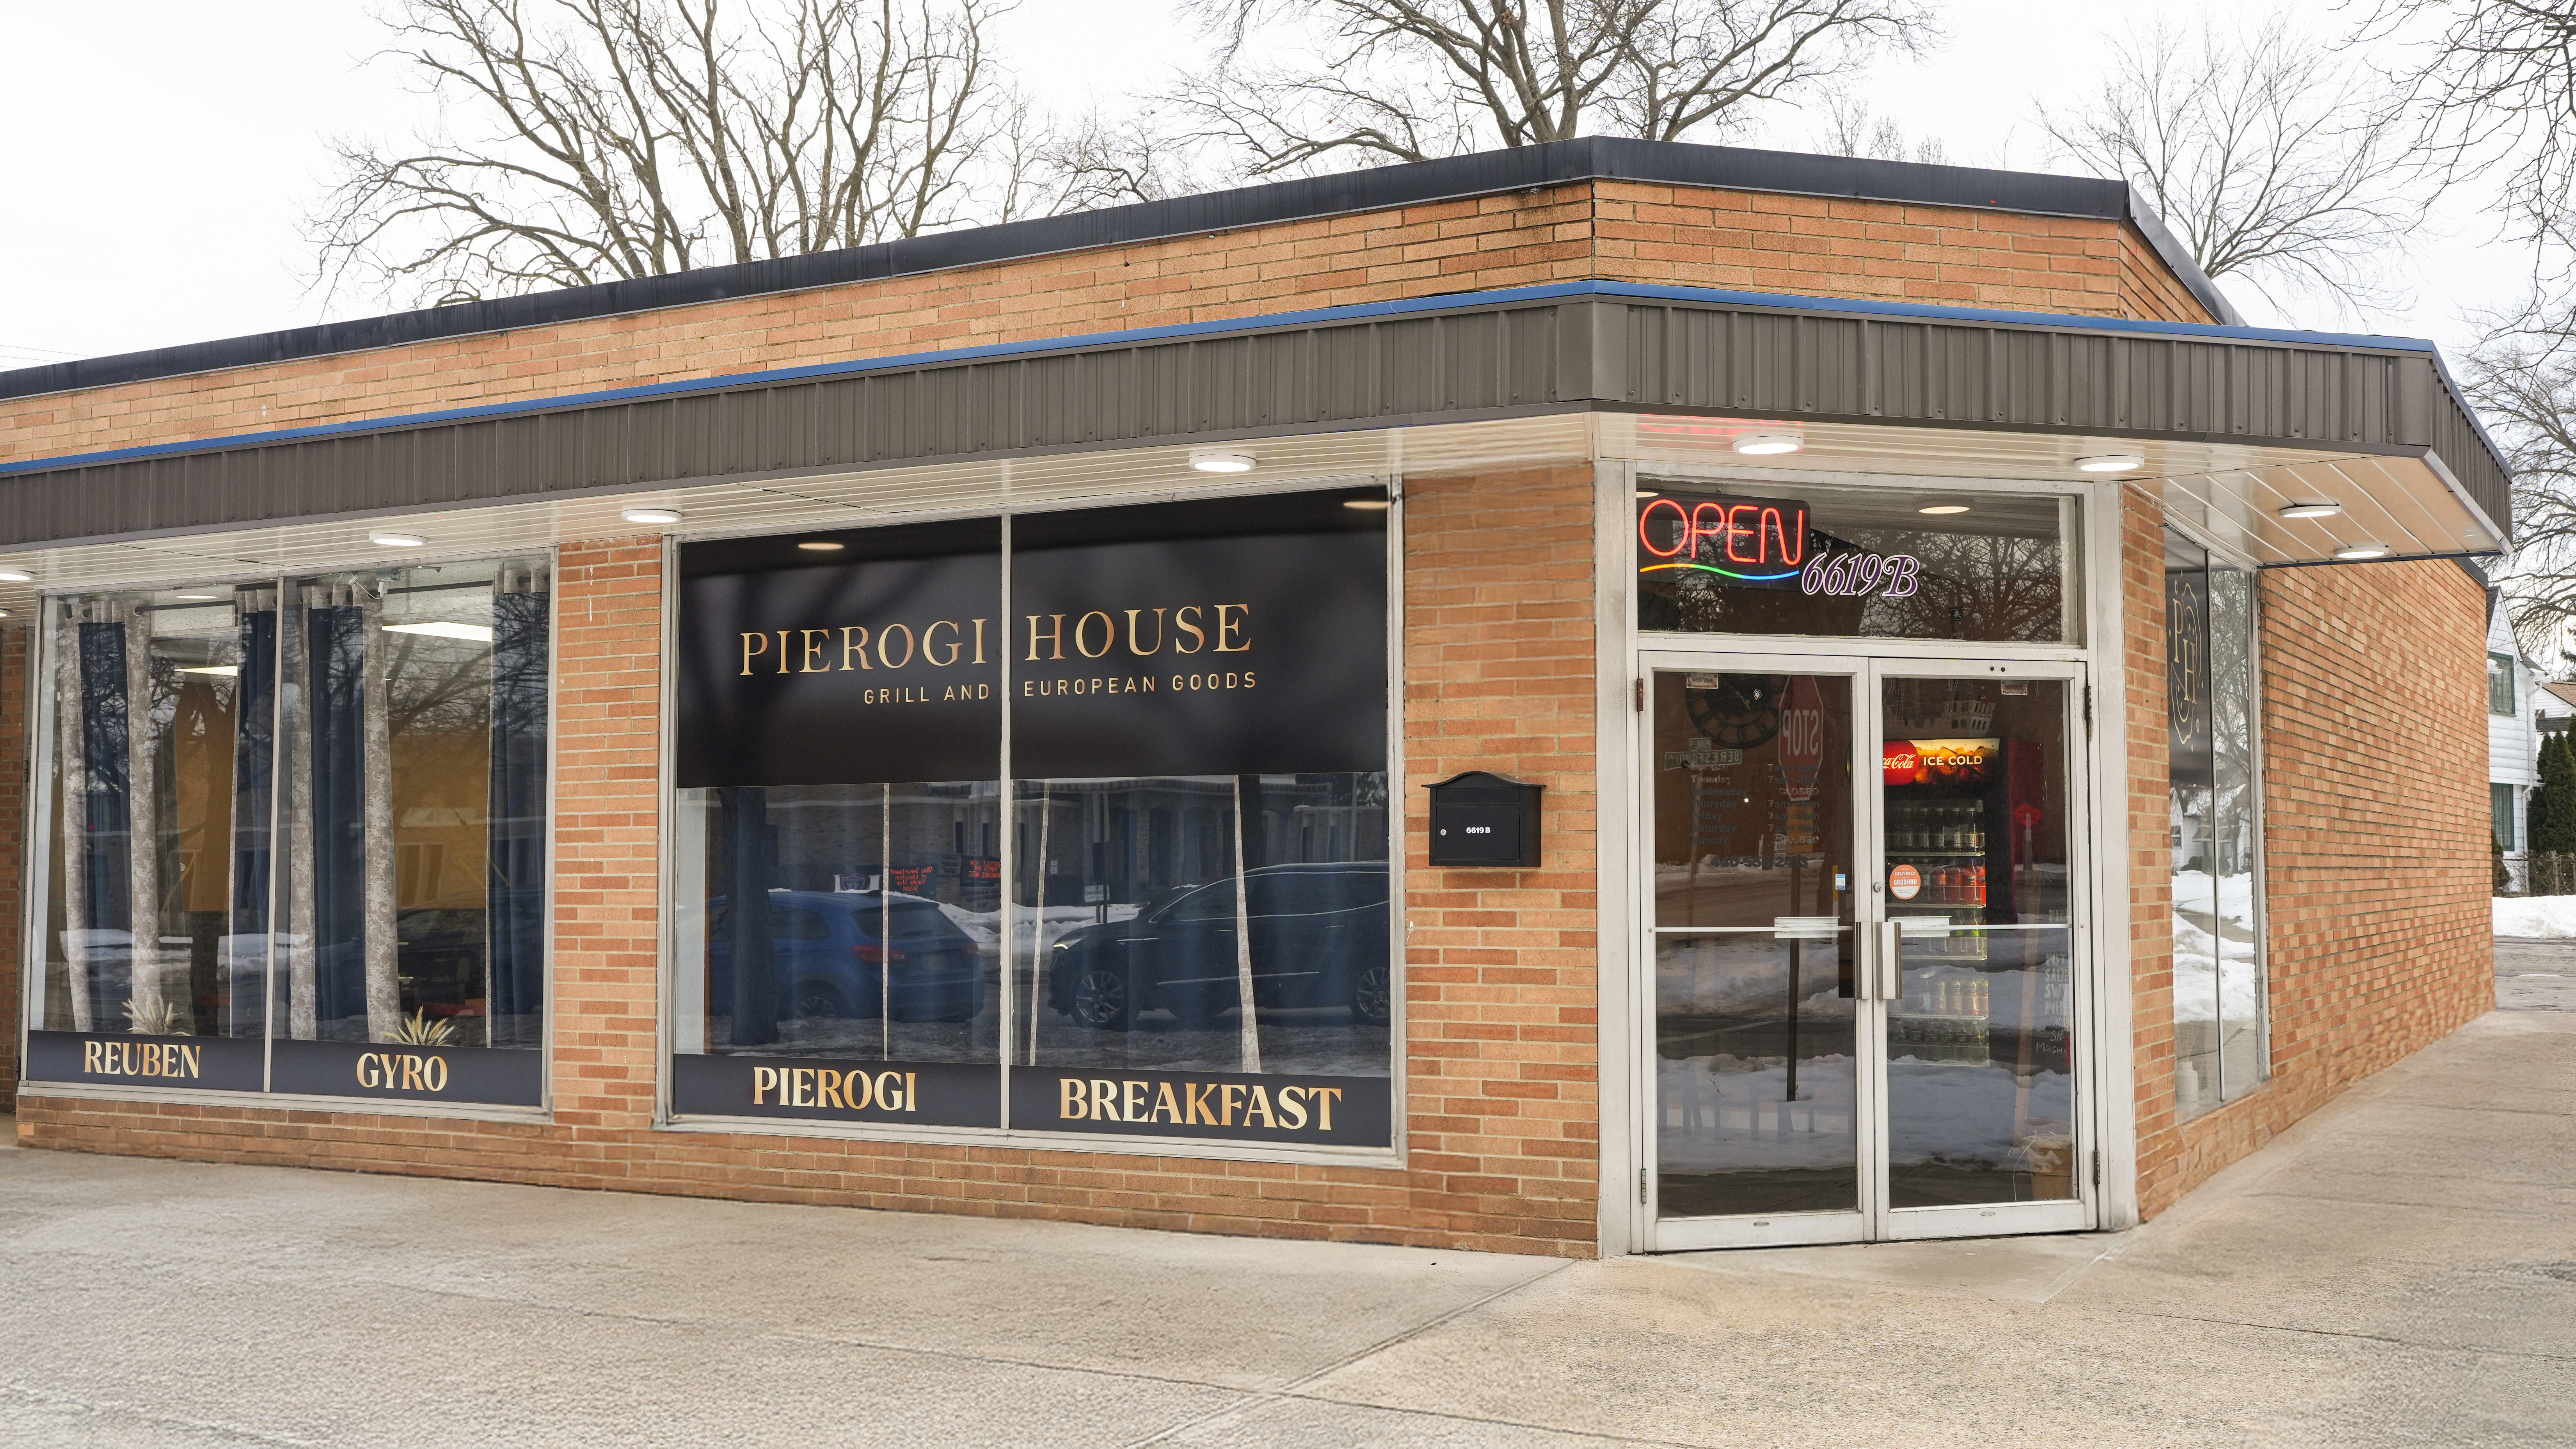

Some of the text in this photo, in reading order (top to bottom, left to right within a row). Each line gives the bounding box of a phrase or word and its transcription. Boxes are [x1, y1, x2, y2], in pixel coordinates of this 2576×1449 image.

[1640, 499, 1803, 566] OPEN
[1801, 552, 1920, 597] 6619B
[741, 604, 1251, 675] PIEROGI HOUSE
[864, 672, 1256, 704] GRILL AND EUROPEAN GOODS
[1883, 753, 1983, 769] ca-Cola ICE COLD
[1691, 774, 1730, 785] Tuesday
[1691, 787, 1747, 797] Wednesday
[1692, 799, 1737, 810] Thursday
[1691, 812, 1722, 822] Friday
[1691, 824, 1737, 834] Saturday
[1691, 836, 1729, 846] Sunday
[84, 1041, 448, 1092] REUBEN GYRO
[753, 1067, 1341, 1130] PIEROGI BREAKFAST
